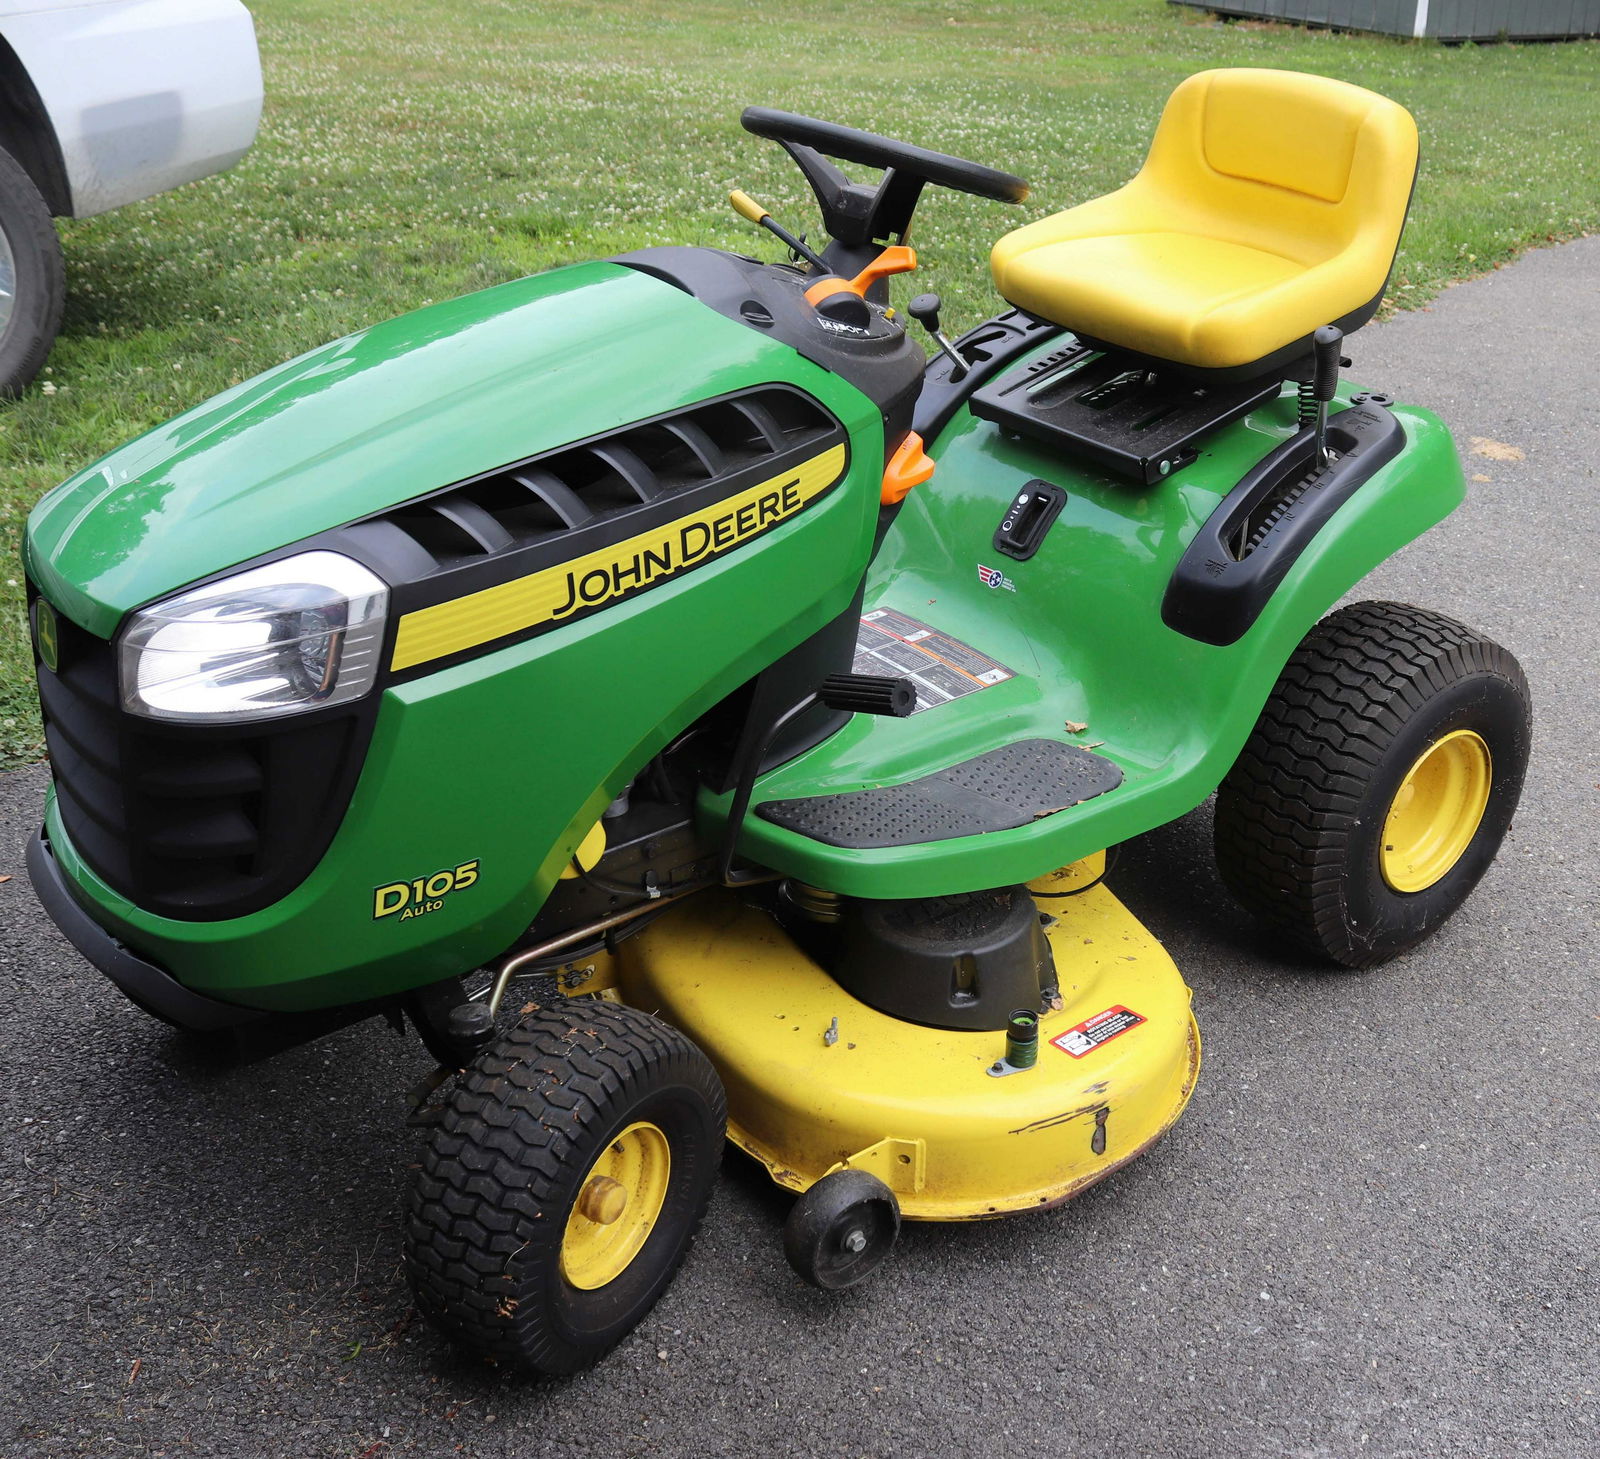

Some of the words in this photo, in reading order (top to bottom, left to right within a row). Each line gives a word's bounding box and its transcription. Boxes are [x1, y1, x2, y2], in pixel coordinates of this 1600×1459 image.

[552, 540, 672, 617] JOHN
[680, 478, 801, 563] DEERE
[374, 860, 479, 919] D105
[399, 899, 444, 922] Auto
